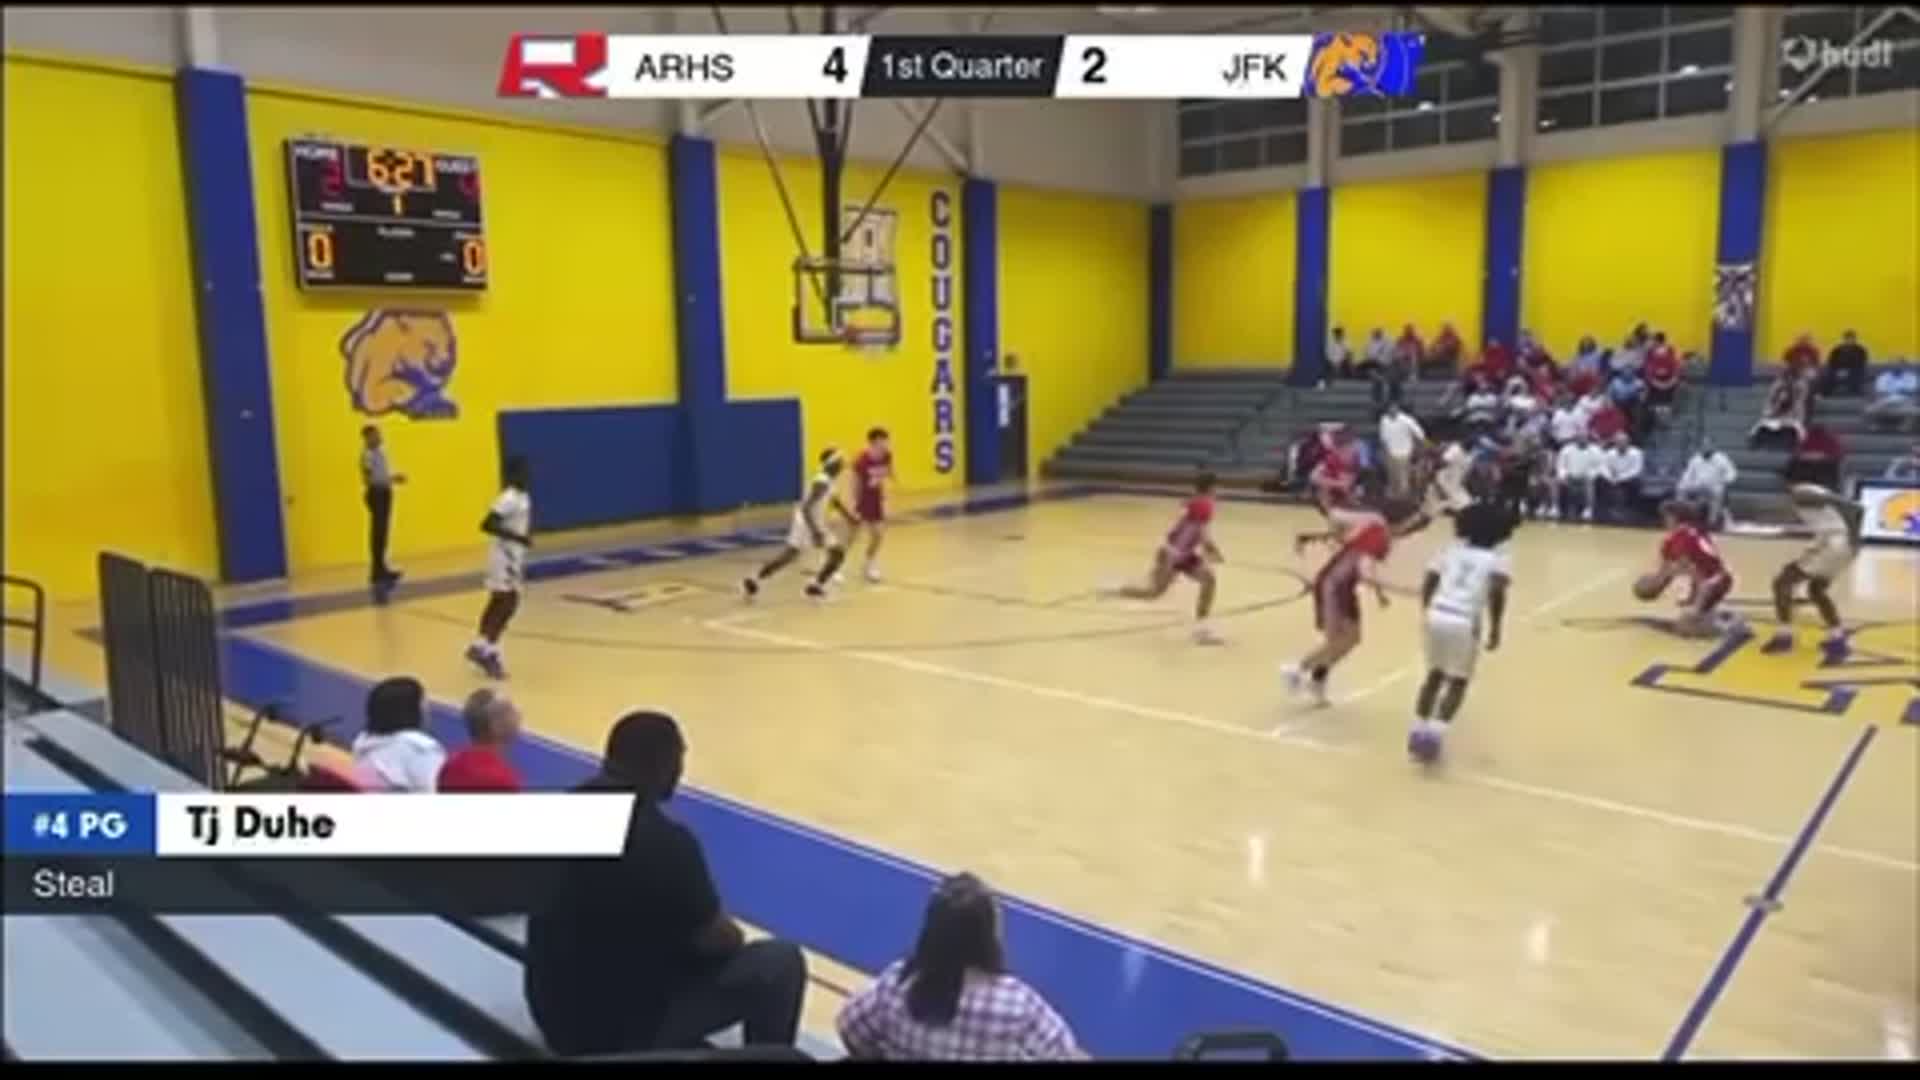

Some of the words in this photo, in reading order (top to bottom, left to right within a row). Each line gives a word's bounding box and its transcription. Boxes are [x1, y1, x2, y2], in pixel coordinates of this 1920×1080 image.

[308, 231, 333, 269] 0
[462, 238, 485, 275] 0
[930, 190, 954, 473] COUGARS
